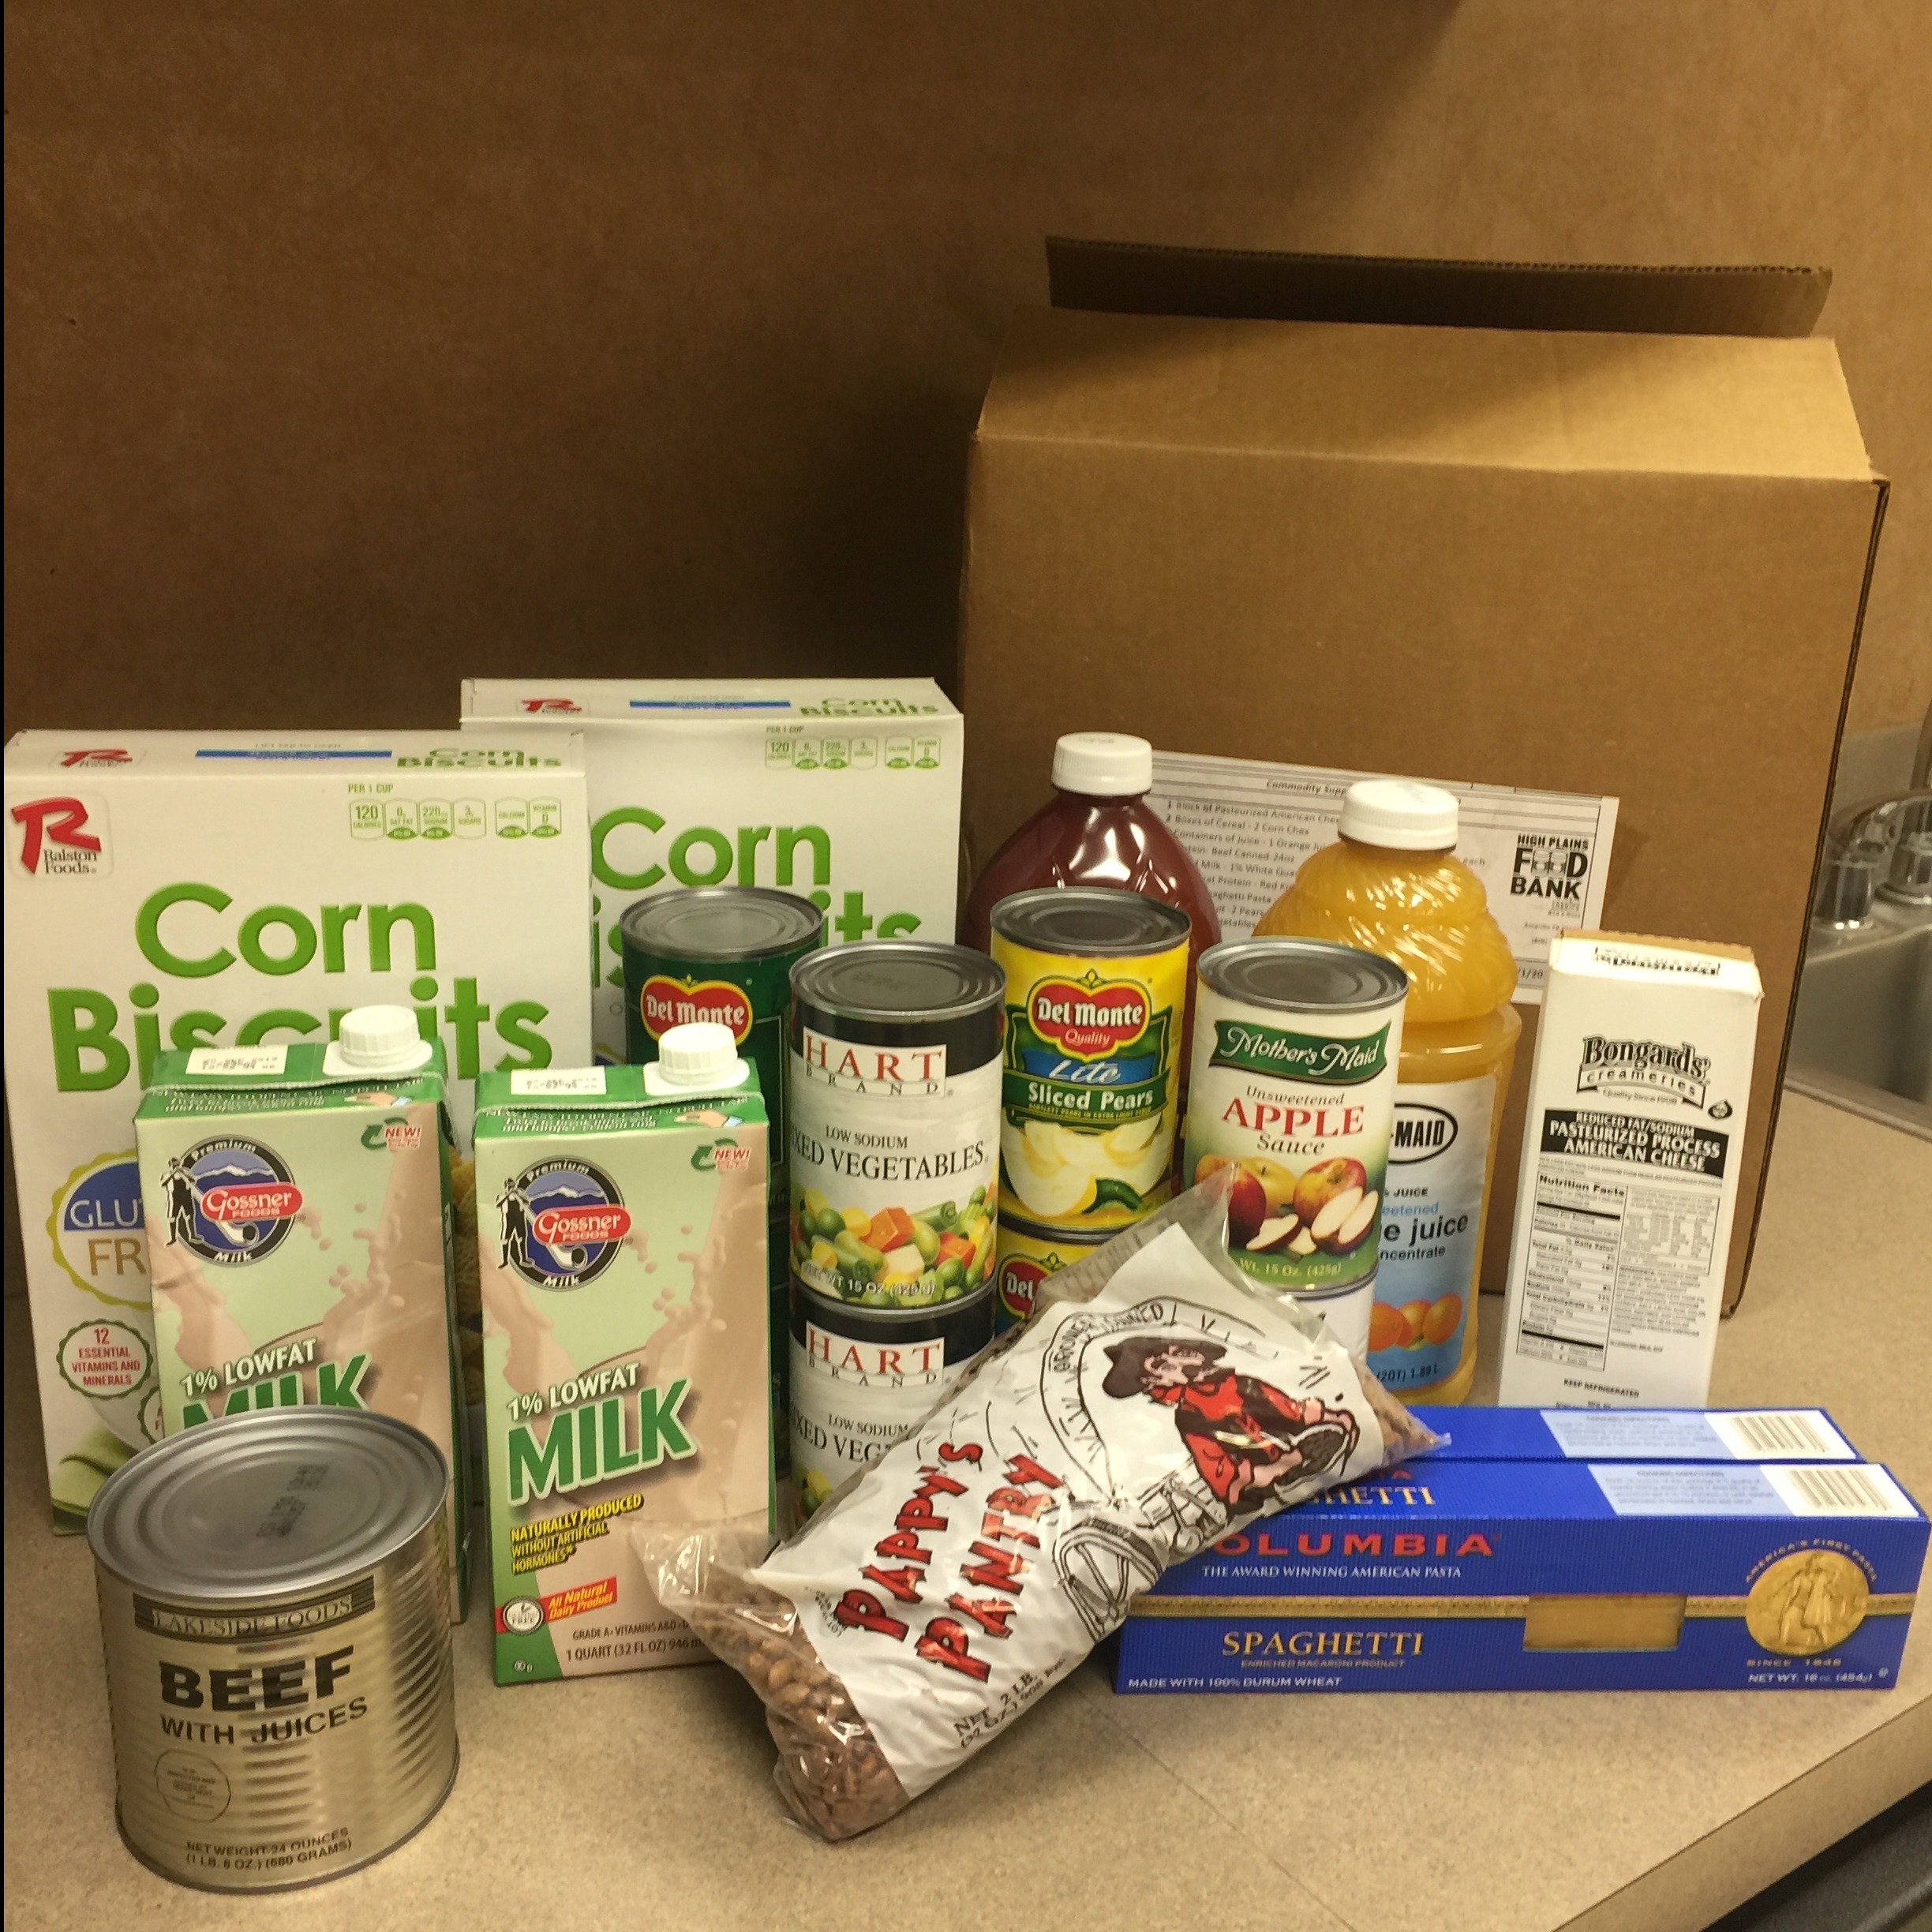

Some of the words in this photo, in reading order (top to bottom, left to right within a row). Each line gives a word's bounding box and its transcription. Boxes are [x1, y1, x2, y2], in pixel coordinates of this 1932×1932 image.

[354, 804, 379, 820] 120
[43, 848, 98, 863] Ralston
[591, 806, 832, 890] Corn
[1517, 833, 1546, 848] HIGH
[1548, 836, 1589, 852] PLAINS
[45, 862, 91, 874] Foods
[1510, 875, 1582, 901] BANK
[135, 882, 436, 978] Corn
[646, 994, 672, 1023] Del
[676, 1002, 745, 1025] Monte
[1037, 997, 1070, 1026] Del
[1074, 1003, 1143, 1028] Monte
[1065, 1028, 1111, 1048] Quality
[1220, 1026, 1317, 1066] Mother's
[1308, 1038, 1380, 1076] Maid
[807, 1035, 942, 1082] HART
[1049, 1060, 1121, 1084] Lite
[806, 1064, 938, 1095] BRAND
[1586, 1069, 1697, 1097] creameries
[1028, 1082, 1091, 1111] Sliced
[1101, 1089, 1153, 1111] Pears
[1246, 1085, 1346, 1105] Unsweetened
[1222, 1097, 1365, 1138] APPLE
[1576, 1111, 1626, 1129] REDUCED
[190, 1138, 256, 1162] Premium
[826, 1125, 852, 1144] LOW
[854, 1132, 908, 1150] SODIUM
[1256, 1133, 1326, 1156] Sauce
[1548, 1118, 1649, 1148] PASTEURIZED
[1651, 1132, 1721, 1159] PROCESS
[714, 1148, 750, 1159] NEW!
[830, 1140, 984, 1181] VEGETABLES
[1563, 1136, 1647, 1163] AMERICAN
[1650, 1148, 1706, 1173] CHEESE
[526, 1159, 590, 1182] Premium
[207, 1190, 293, 1221] Gossner
[1393, 1187, 1429, 1198] JUICE
[538, 1212, 622, 1245] Gossner
[1409, 1213, 1469, 1248] juice
[214, 1250, 253, 1263] Milk
[543, 1275, 582, 1287] Milk
[1006, 1272, 1034, 1300] Del
[93, 1328, 110, 1345] 12
[78, 1346, 131, 1359] ESSENTIAL
[809, 1328, 941, 1375] HART
[71, 1361, 118, 1374] VITAMINS
[121, 1361, 140, 1372] AND
[83, 1374, 133, 1387] MINERALS
[181, 1369, 218, 1397] 1%
[223, 1338, 316, 1387] LOWFAT
[809, 1354, 938, 1389] BRAND
[507, 1391, 543, 1421] 1%
[549, 1362, 640, 1409] LOWFAT
[829, 1413, 855, 1432] LOW
[856, 1421, 908, 1437] SODIUM
[507, 1376, 698, 1507] MILK
[511, 1511, 578, 1543] NATURALLY
[580, 1493, 644, 1523] PRODUCED
[511, 1533, 556, 1558] WITHOUT
[556, 1520, 609, 1547] ARTIFICIAL
[834, 1441, 984, 1642] PAPPY'S
[1812, 1538, 1851, 1552] FIRST
[916, 1452, 1065, 1683] PANTRY
[1202, 1565, 1229, 1578] THE
[1231, 1565, 1279, 1578] AWARD
[1283, 1566, 1348, 1578] WINNING
[1351, 1565, 1421, 1578] AMERICAN
[1425, 1565, 1462, 1578] PASTA
[549, 1597, 563, 1608] All
[565, 1580, 608, 1604] Natural
[549, 1605, 575, 1621] Dairy
[577, 1592, 613, 1612] Product
[153, 1607, 267, 1638] LAKESIDE
[275, 1593, 353, 1631] FOODS
[573, 1627, 602, 1641] GRADE
[615, 1622, 656, 1637] VITAMINS
[1222, 1631, 1425, 1657] SPAGHETTI
[566, 1649, 572, 1661] 1
[575, 1646, 612, 1661] QUART
[613, 1643, 631, 1659] (32
[634, 1642, 645, 1654] FL
[648, 1640, 666, 1654] OZ)
[668, 1638, 688, 1651] 946
[1241, 1659, 1296, 1668] ENRICHED
[1297, 1659, 1353, 1668] MACARONI
[1355, 1659, 1406, 1668] PRODUCT
[1747, 1658, 1792, 1668] SINCE
[159, 1644, 354, 1712] BEEF
[1129, 1678, 1167, 1688] MADE
[1170, 1678, 1204, 1688] WITH
[1208, 1677, 1241, 1688] 100%
[1243, 1676, 1292, 1687] DURUM
[1294, 1676, 1342, 1687] WHEAT
[1748, 1673, 1777, 1683] NET
[160, 1713, 236, 1745] WITH
[250, 1695, 369, 1745] JUICES
[953, 1706, 990, 1737] NET
[1000, 1693, 1011, 1705] 2
[186, 1840, 211, 1854] NET
[214, 1843, 266, 1856] WEIGHT
[290, 1826, 350, 1852] OUNCES
[297, 1838, 353, 1865] GRAMS)
